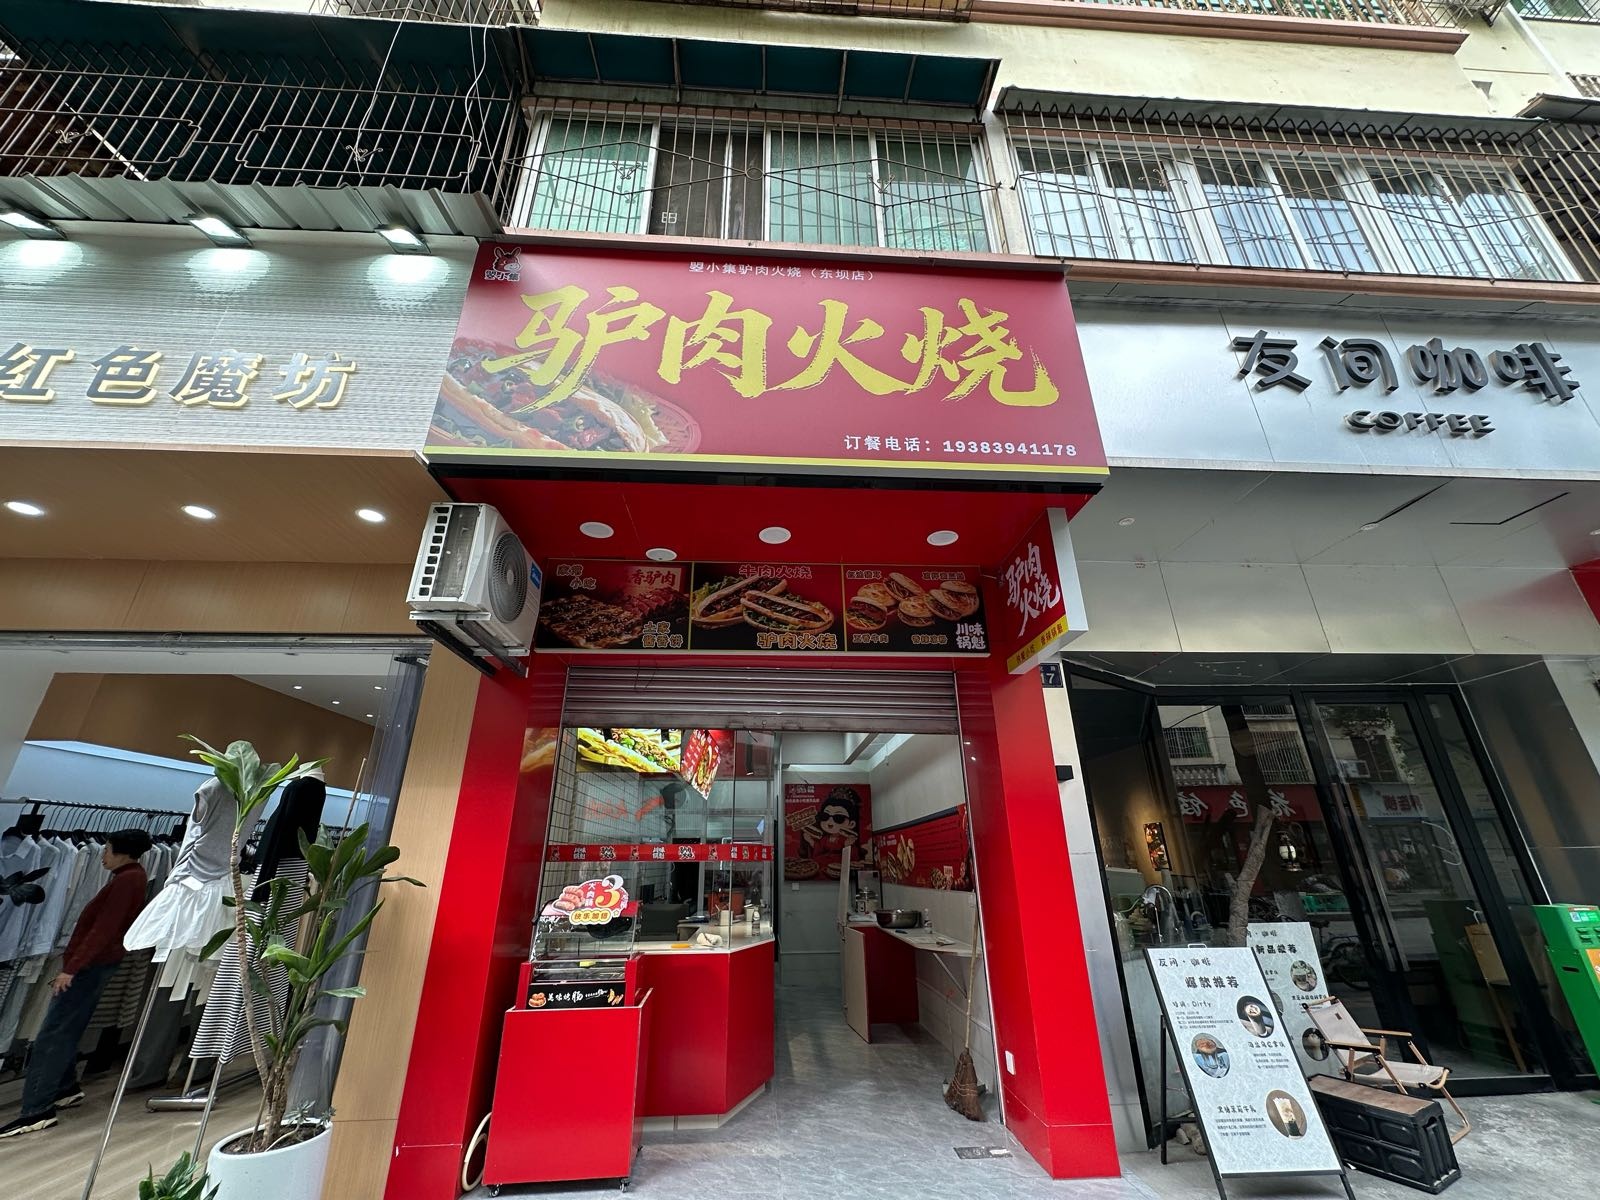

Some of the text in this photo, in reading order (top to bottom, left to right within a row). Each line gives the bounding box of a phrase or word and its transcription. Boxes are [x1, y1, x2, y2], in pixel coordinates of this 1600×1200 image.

[483, 284, 1060, 416] 驴肉火烧
[1231, 329, 1580, 401] 友间咖啡
[0, 342, 358, 410] 红色魔坊
[1346, 410, 1496, 435] COFFEE
[738, 564, 813, 580] 牛肉火烧
[1005, 542, 1041, 607] 驴肉
[1018, 572, 1061, 637] 火烧
[642, 621, 671, 635] 土家
[955, 622, 985, 636] 川味
[642, 634, 683, 648] 酱香饼
[756, 631, 839, 649] 驴肉火烧
[956, 635, 986, 650] 锅魁
[595, 875, 624, 908] 3
[1255, 944, 1298, 955] 新品推荐
[1184, 976, 1240, 989] 爆款推荐
